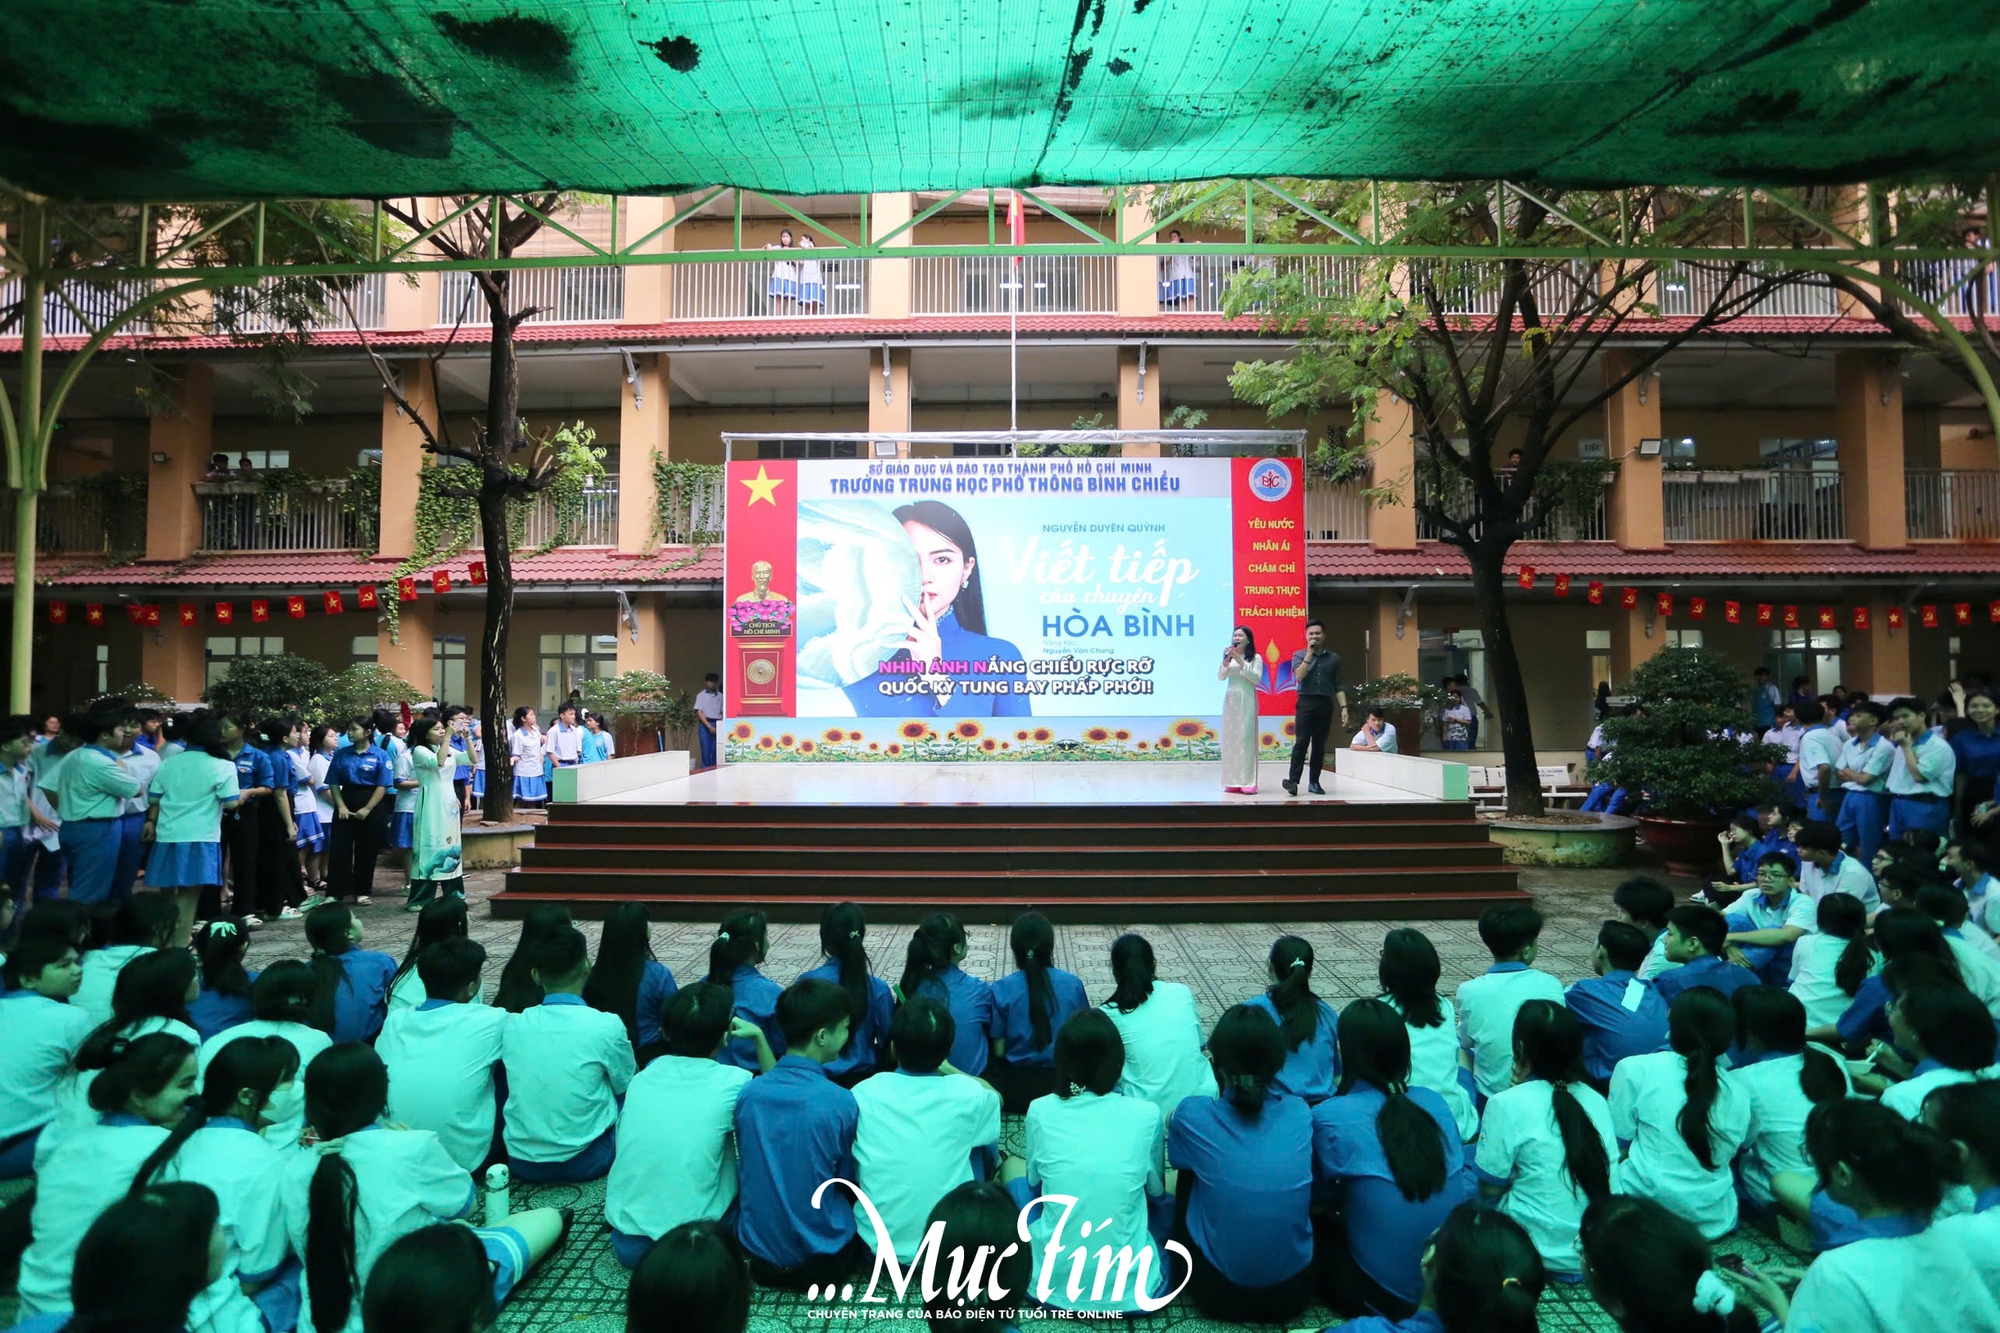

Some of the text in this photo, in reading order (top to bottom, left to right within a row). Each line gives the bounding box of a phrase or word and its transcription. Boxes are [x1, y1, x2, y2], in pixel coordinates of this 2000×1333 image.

[886, 461, 909, 475] GIÁO
[914, 464, 936, 476] DỤC
[940, 461, 953, 475] VÀ
[956, 461, 978, 475] ĐÀO
[983, 463, 1003, 476] TẠO
[1096, 460, 1115, 474] CHÍ
[1121, 463, 1152, 474] MINH
[830, 473, 894, 493] TRƯỜNG
[899, 477, 952, 493] TRUNG
[956, 477, 988, 495] HỌC
[1028, 474, 1083, 492] THÔNG
[1132, 470, 1180, 492] CHIỂU
[1042, 521, 1165, 533] NGUYỄN DUYÊN QUỲNH
[1247, 517, 1295, 529] YÊU NƯỚC
[1252, 539, 1290, 551] NHÂN ÁI
[1005, 535, 1200, 607] Viết tiếp
[1278, 561, 1296, 573] CHỈ
[1243, 585, 1301, 597] TRUNG THỰC
[1039, 582, 1159, 615] câu chuyện
[1239, 605, 1306, 618] TRÁCH NHIỆM
[1042, 606, 1195, 637] HÒA BÌNH
[1090, 646, 1115, 655] Chung
[878, 655, 1155, 677] NHÌN ÁNH NẮNG CHIẾU RỰC RỠ
[878, 675, 1154, 696] QUỐC KỲ TUNG BAY PHẤP PHỚI!
